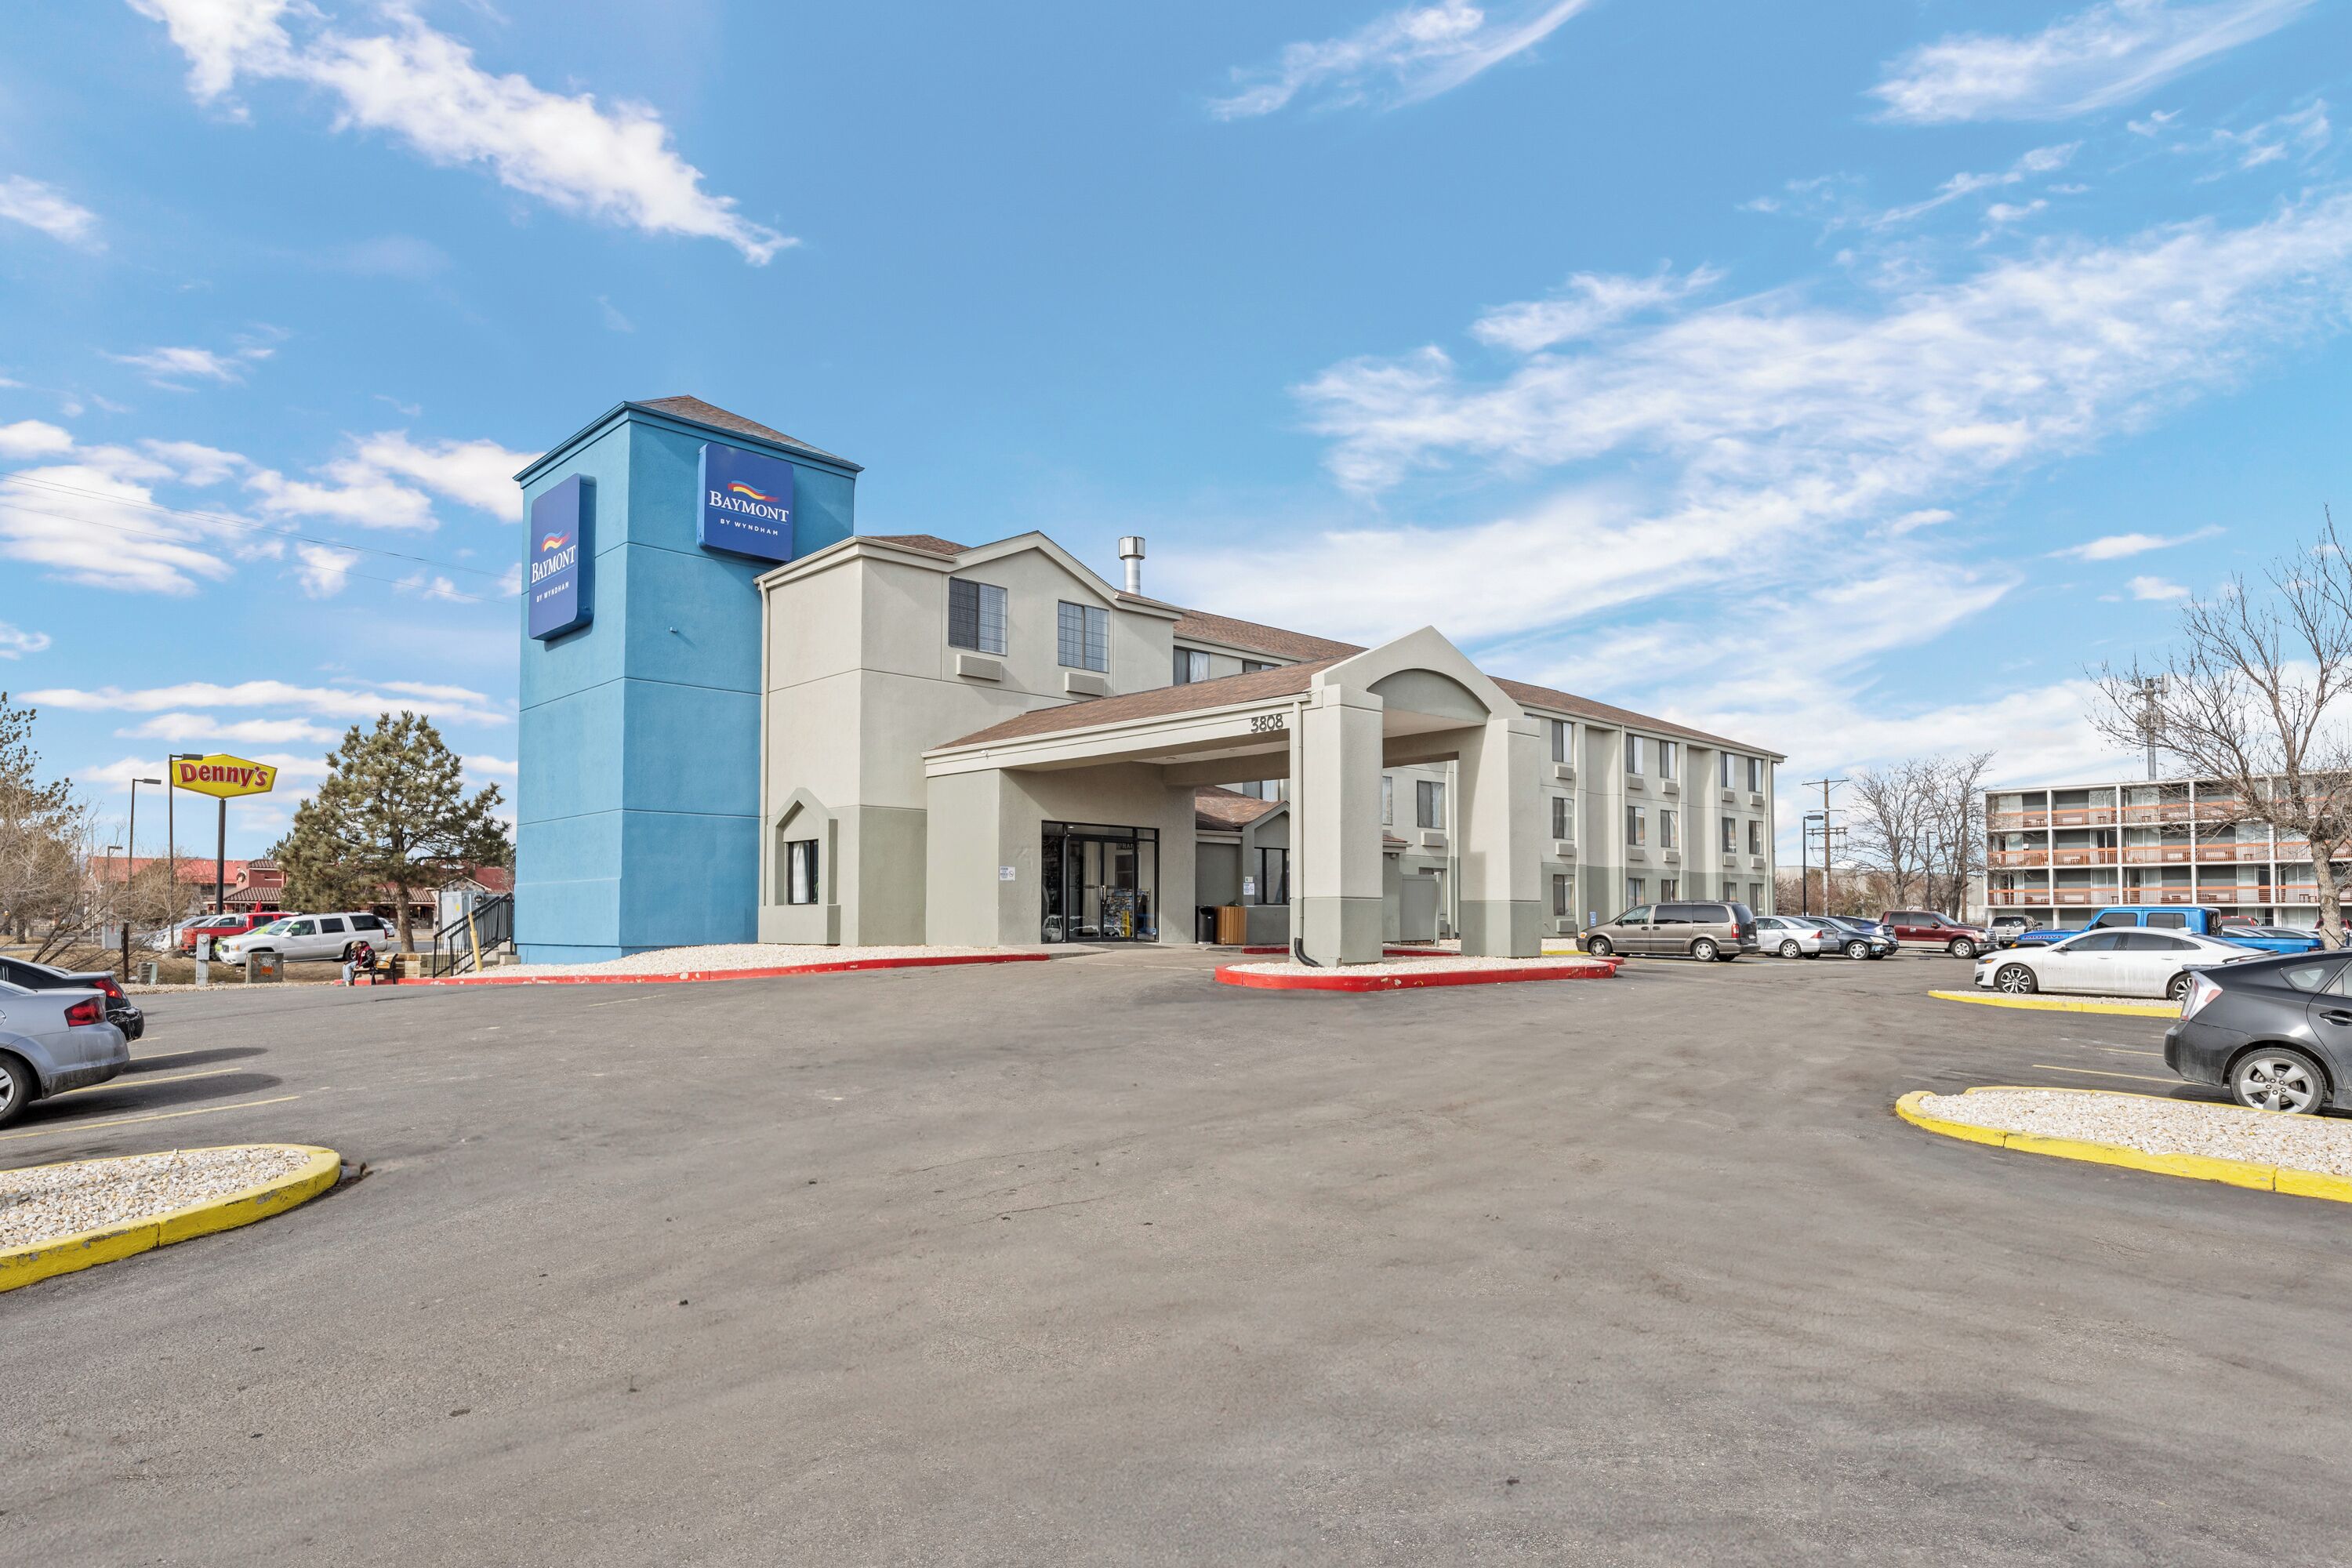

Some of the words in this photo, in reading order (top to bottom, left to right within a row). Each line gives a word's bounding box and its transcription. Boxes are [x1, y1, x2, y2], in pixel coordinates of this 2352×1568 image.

[709, 490, 789, 522] BAYMONT
[734, 521, 778, 535] WYNDHAM
[531, 544, 576, 584] BAYMONT
[536, 594, 543, 603] BY
[544, 581, 569, 599] WYNDHAM
[1250, 713, 1283, 733] 3808
[179, 763, 268, 788] Denny's
